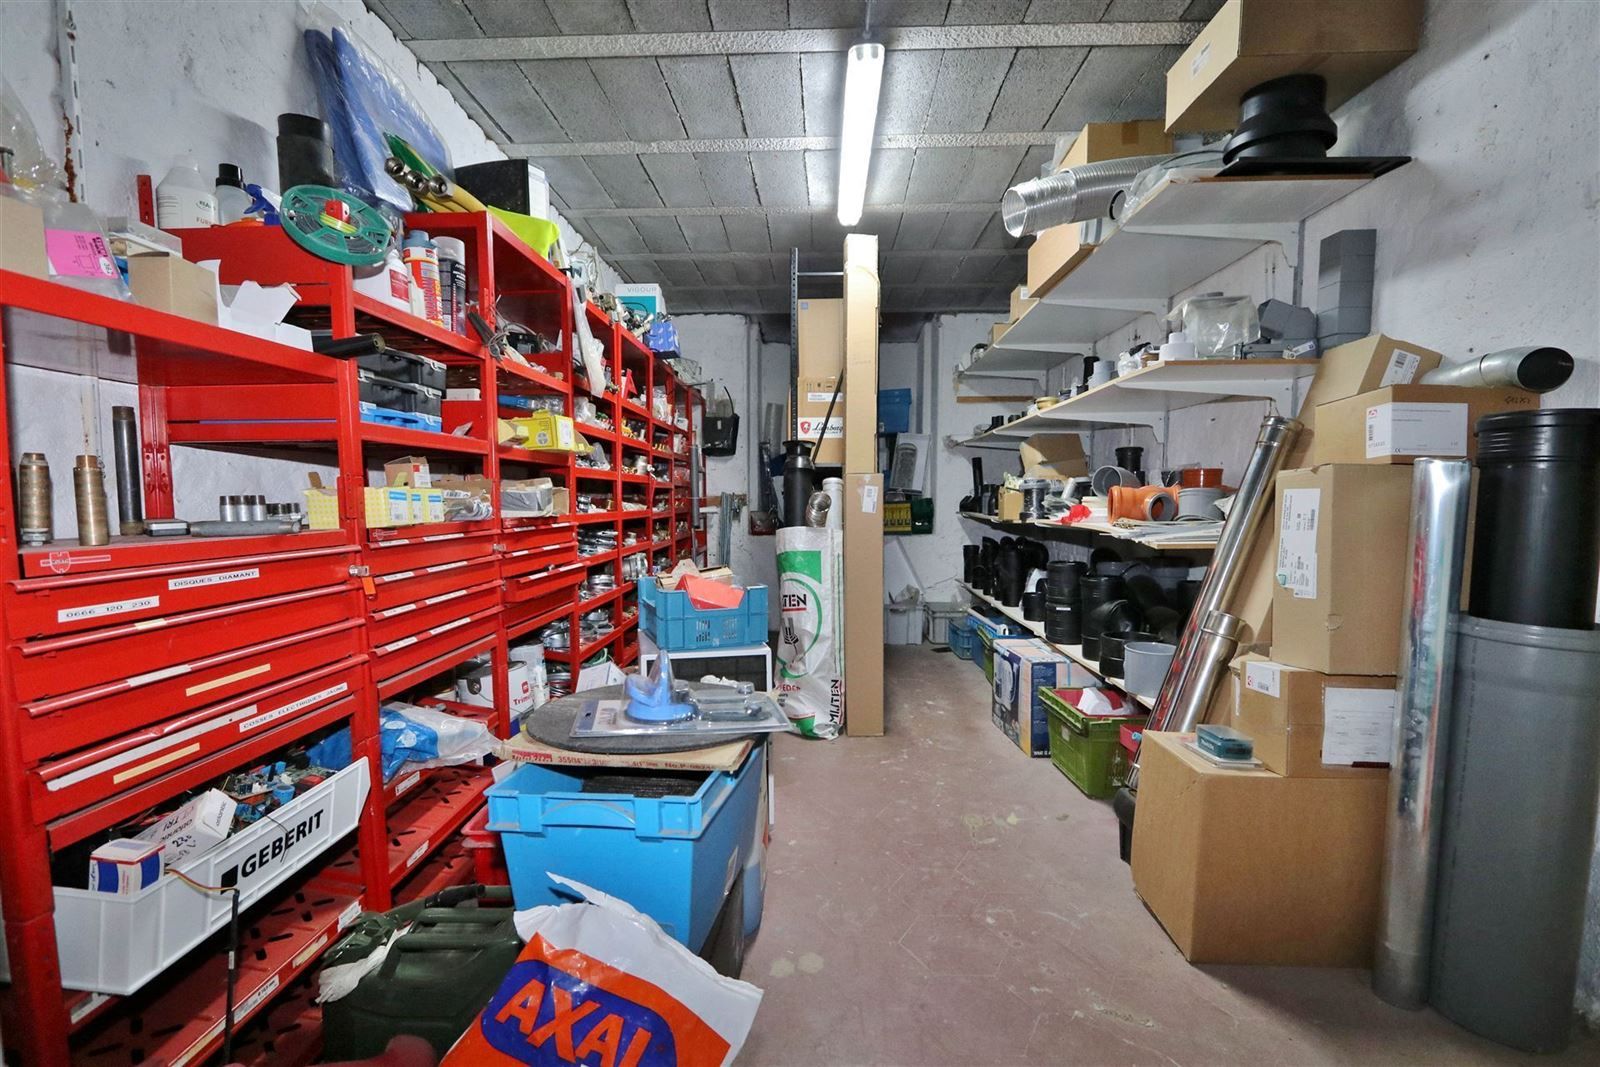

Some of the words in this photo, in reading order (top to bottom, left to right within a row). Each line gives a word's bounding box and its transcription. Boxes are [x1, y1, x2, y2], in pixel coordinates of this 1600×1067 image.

[174, 577, 213, 587] DISQUES
[219, 571, 257, 581] DIAMANT
[66, 608, 96, 618] 0666
[106, 604, 124, 612] 120
[132, 600, 151, 608] 230
[243, 714, 274, 729] COSSES
[241, 808, 324, 878] GEBERIT
